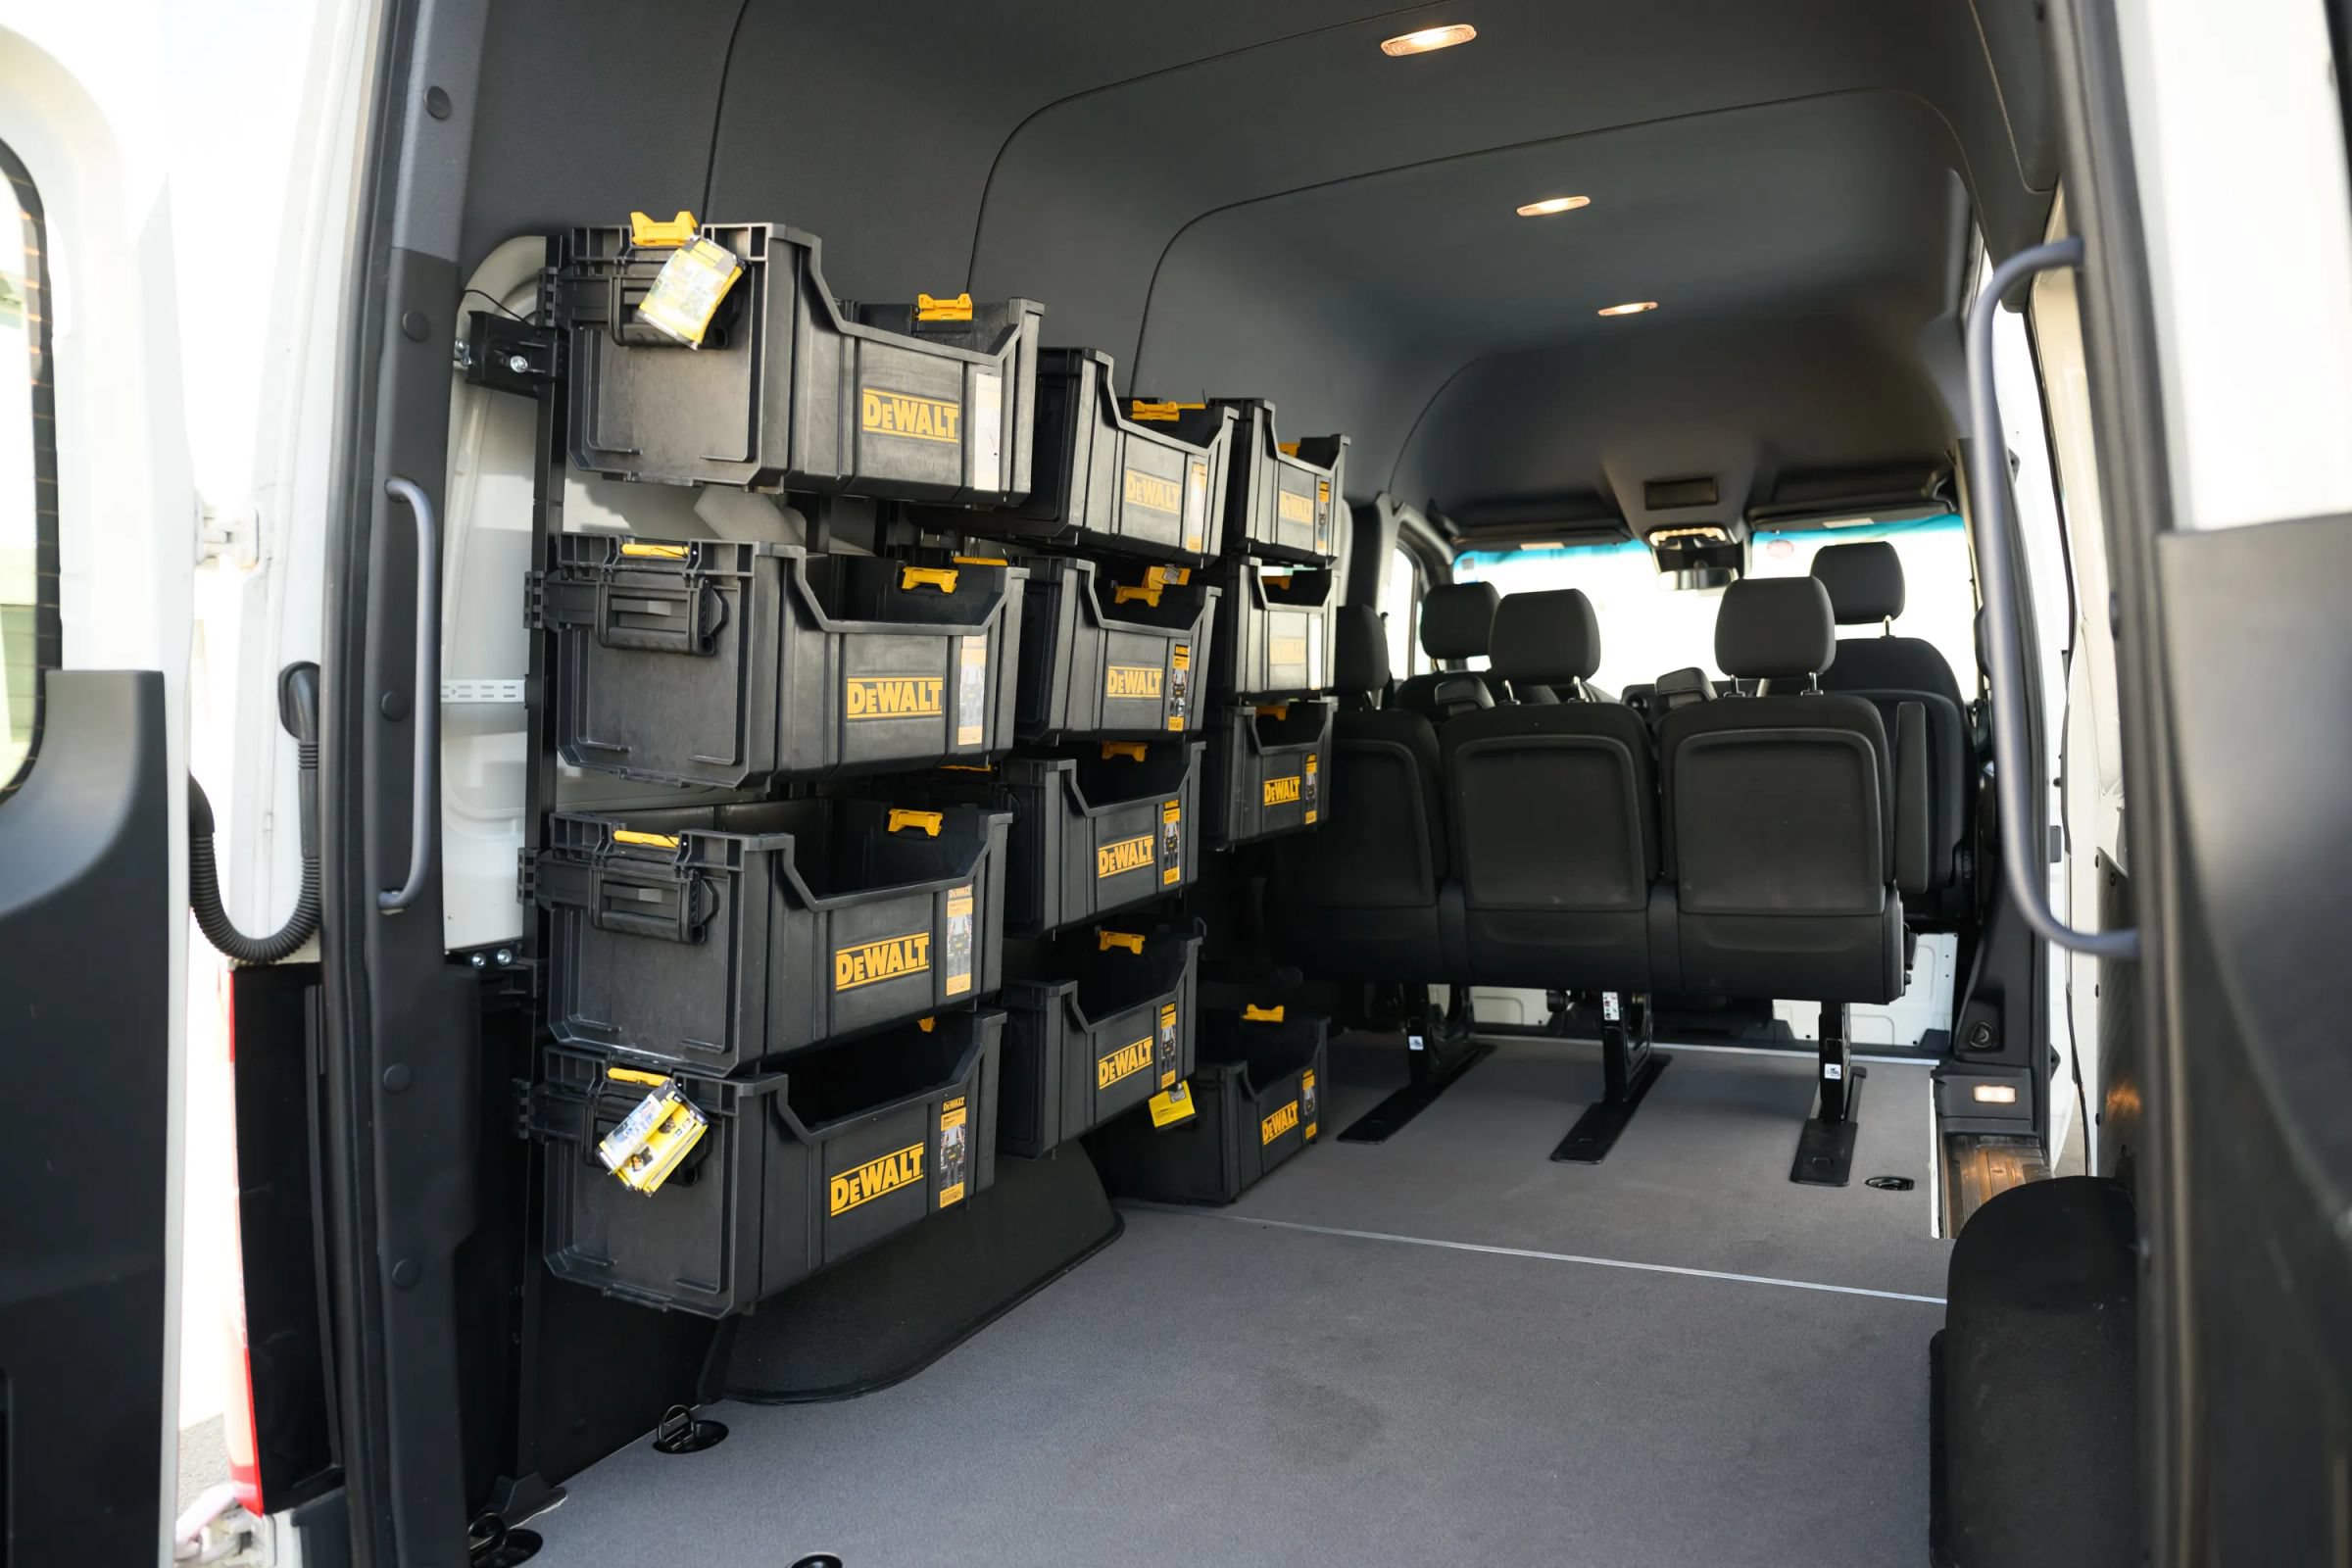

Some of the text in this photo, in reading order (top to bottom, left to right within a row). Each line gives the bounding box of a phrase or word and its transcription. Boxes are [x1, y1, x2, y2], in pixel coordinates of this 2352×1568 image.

[862, 392, 959, 439] DEWALT
[847, 681, 943, 714] DEWALT
[1107, 668, 1163, 696] DEWALT
[1264, 778, 1300, 803] DEWALT
[1099, 838, 1153, 874] DEWALT
[836, 937, 929, 986] DEWALT
[1099, 1040, 1152, 1085] DEWALT
[1262, 1102, 1298, 1144] DEWALT
[831, 1146, 923, 1213] DEWALT
